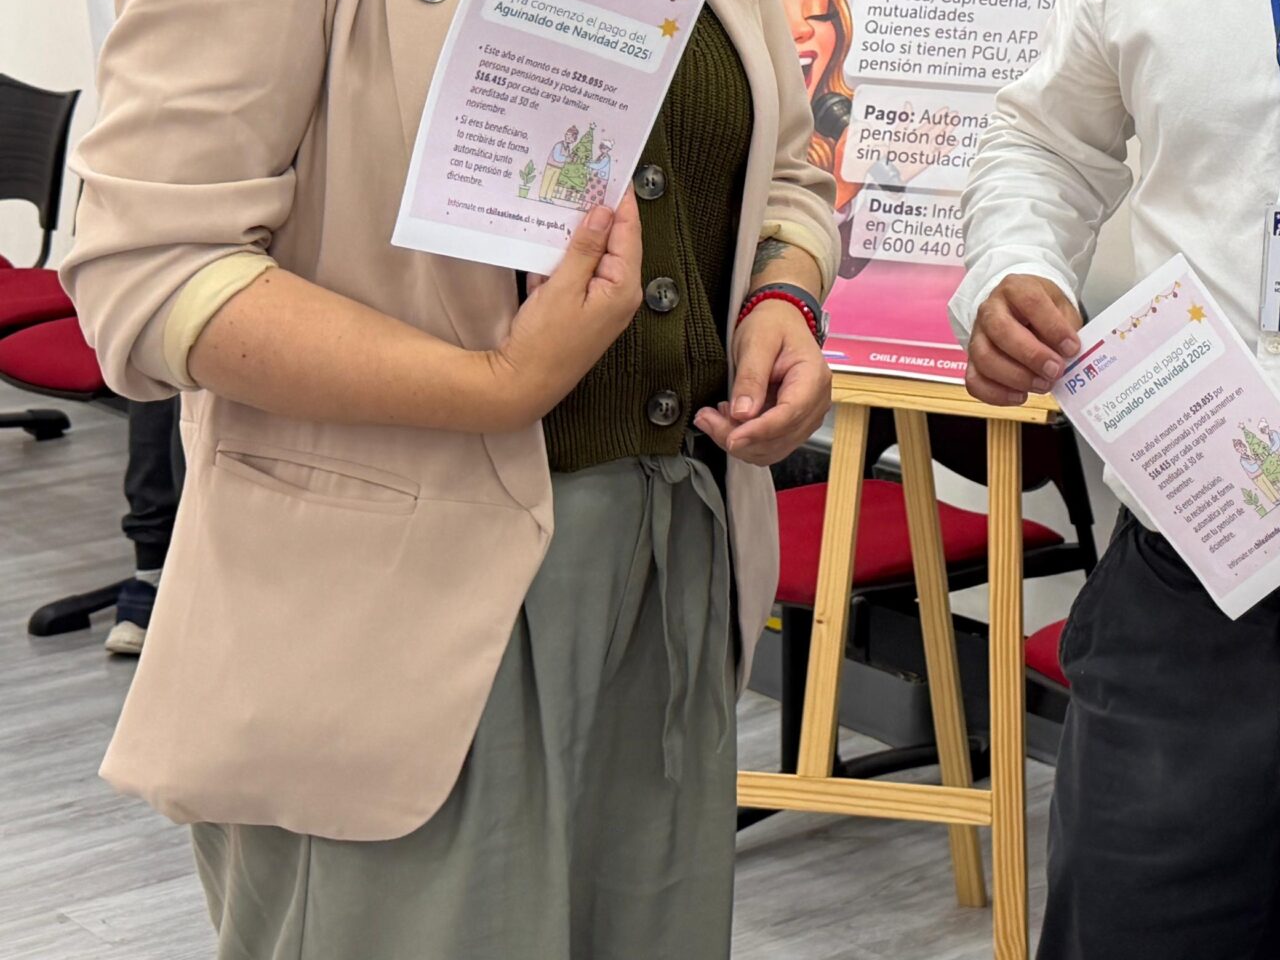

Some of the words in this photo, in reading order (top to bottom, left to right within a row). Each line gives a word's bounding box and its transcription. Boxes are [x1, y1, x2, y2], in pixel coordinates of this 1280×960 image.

[866, 4, 974, 23] mutualidades
[493, 0, 553, 28] Aguinaldo
[554, 20, 570, 34] de
[571, 24, 619, 49] Navidad
[618, 40, 652, 60] 2025!
[864, 18, 930, 38] Quienes
[934, 26, 978, 41] están
[981, 30, 1002, 43] en
[1005, 29, 1038, 44] AFP
[861, 38, 896, 53] solo
[899, 41, 912, 55] si
[916, 43, 967, 59] tienen
[971, 45, 1012, 63] PGU,
[1016, 48, 1041, 63] AP
[857, 58, 922, 74] pensión
[926, 63, 986, 78] mínima
[863, 104, 915, 125] Pago:
[919, 108, 989, 129] Automá
[858, 127, 930, 144] pensión
[934, 130, 957, 146] de
[962, 133, 978, 148] di
[856, 147, 881, 161] sin
[868, 198, 927, 217] Dudas:
[932, 204, 964, 220] Info
[865, 220, 886, 233] en
[891, 220, 964, 239] ChileAtie
[863, 236, 877, 250] el
[882, 236, 915, 254] 600
[919, 241, 950, 257] 440
[869, 352, 897, 363] CHILE
[897, 355, 935, 367] AVANZA
[1064, 370, 1087, 397] IPS
[1102, 395, 1144, 432] Aguinaldo
[1142, 386, 1156, 399] de
[1152, 357, 1189, 390] Navidad
[1186, 338, 1211, 364] 2025!
